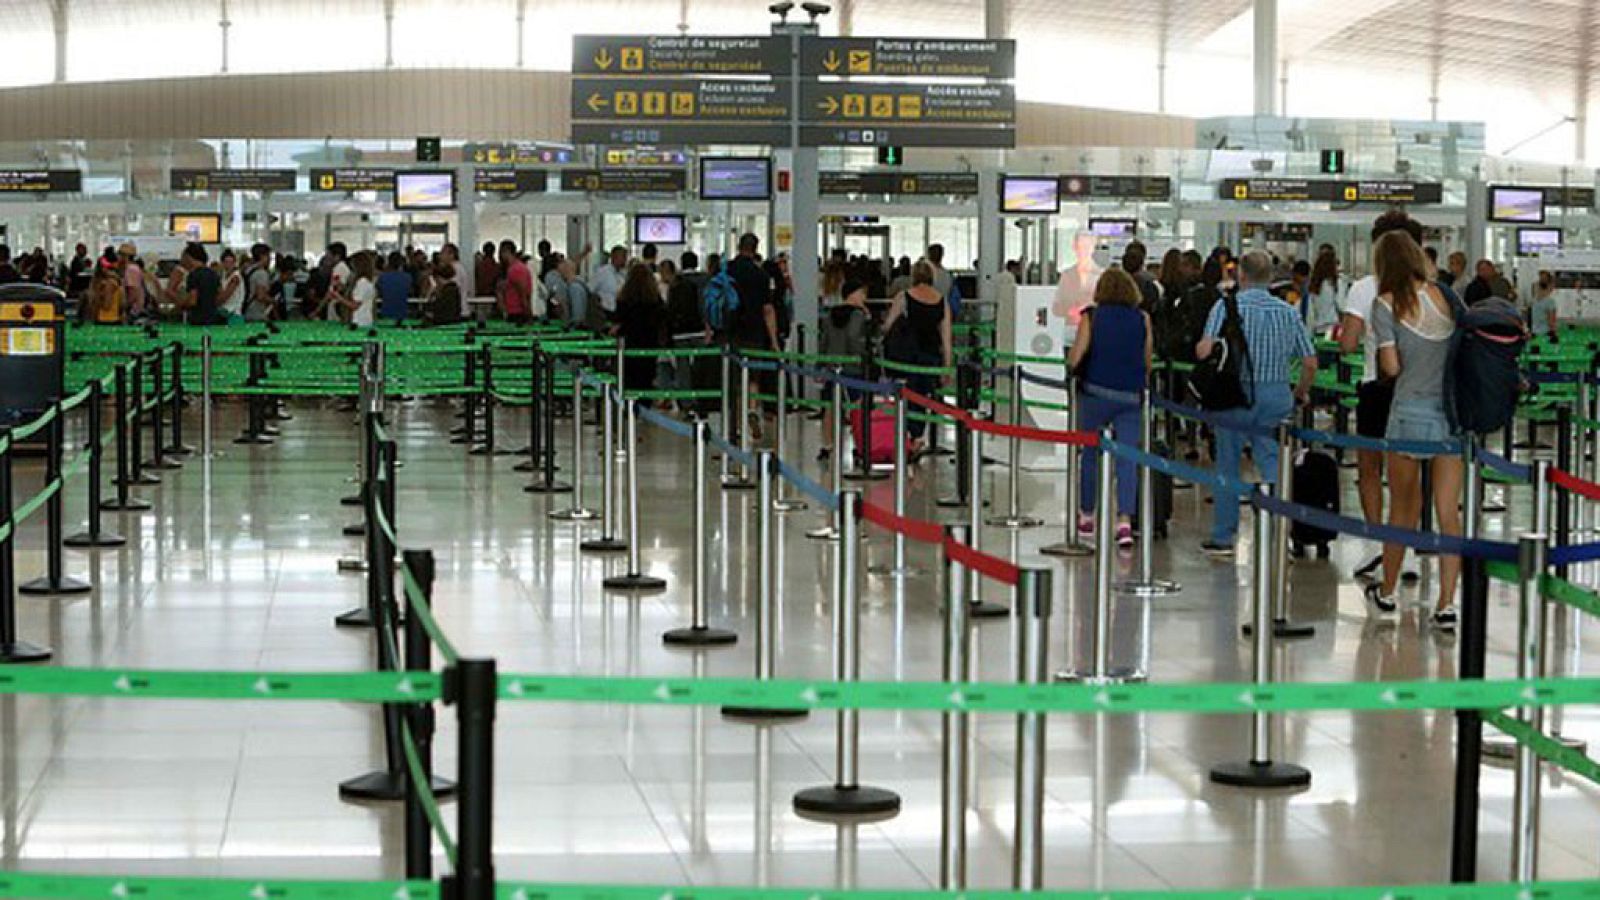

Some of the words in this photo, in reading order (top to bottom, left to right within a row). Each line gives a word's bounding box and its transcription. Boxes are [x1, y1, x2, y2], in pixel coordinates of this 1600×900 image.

[649, 38, 688, 48] Control
[692, 38, 705, 48] de
[875, 40, 911, 50] Portes
[649, 60, 688, 70] Control
[692, 61, 705, 70] de
